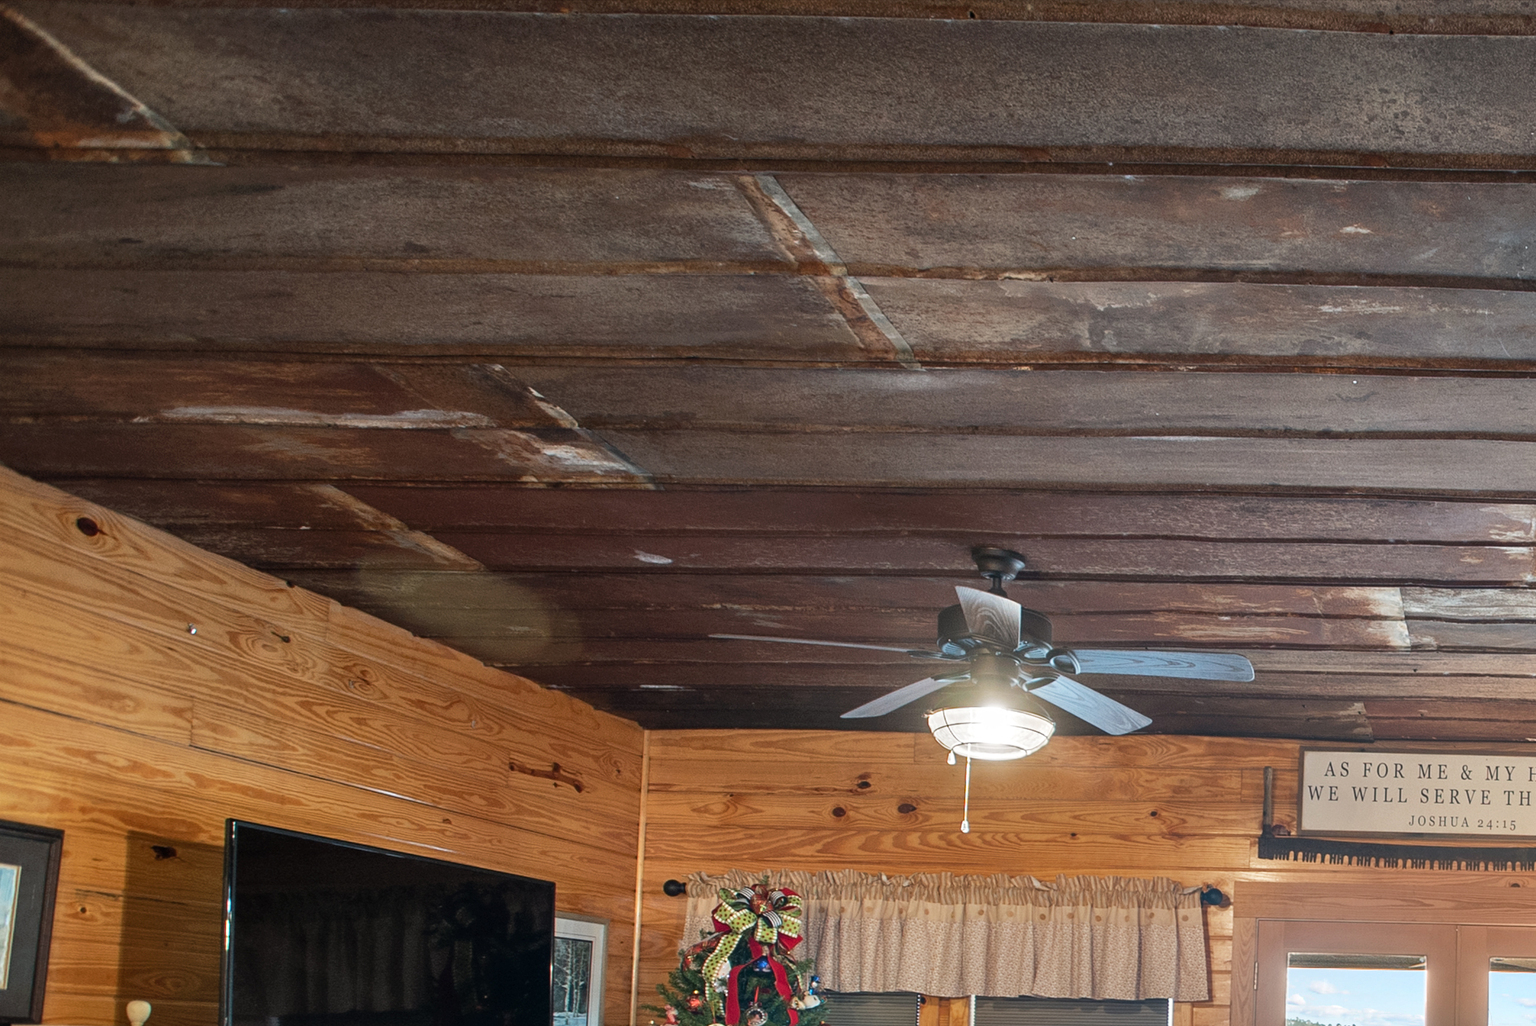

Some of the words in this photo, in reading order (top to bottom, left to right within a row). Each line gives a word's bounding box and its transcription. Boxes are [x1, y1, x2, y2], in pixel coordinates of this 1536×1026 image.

[1324, 762, 1350, 777] AS
[1362, 763, 1405, 778] FOR
[1417, 764, 1449, 780] ME
[1460, 765, 1473, 780] &
[1485, 766, 1517, 782] MY
[1308, 786, 1340, 801] WE
[1352, 787, 1408, 804] WILL
[1420, 788, 1492, 805] SERVE
[1408, 815, 1470, 828] JOSHUA
[1477, 819, 1517, 831] 24:15
